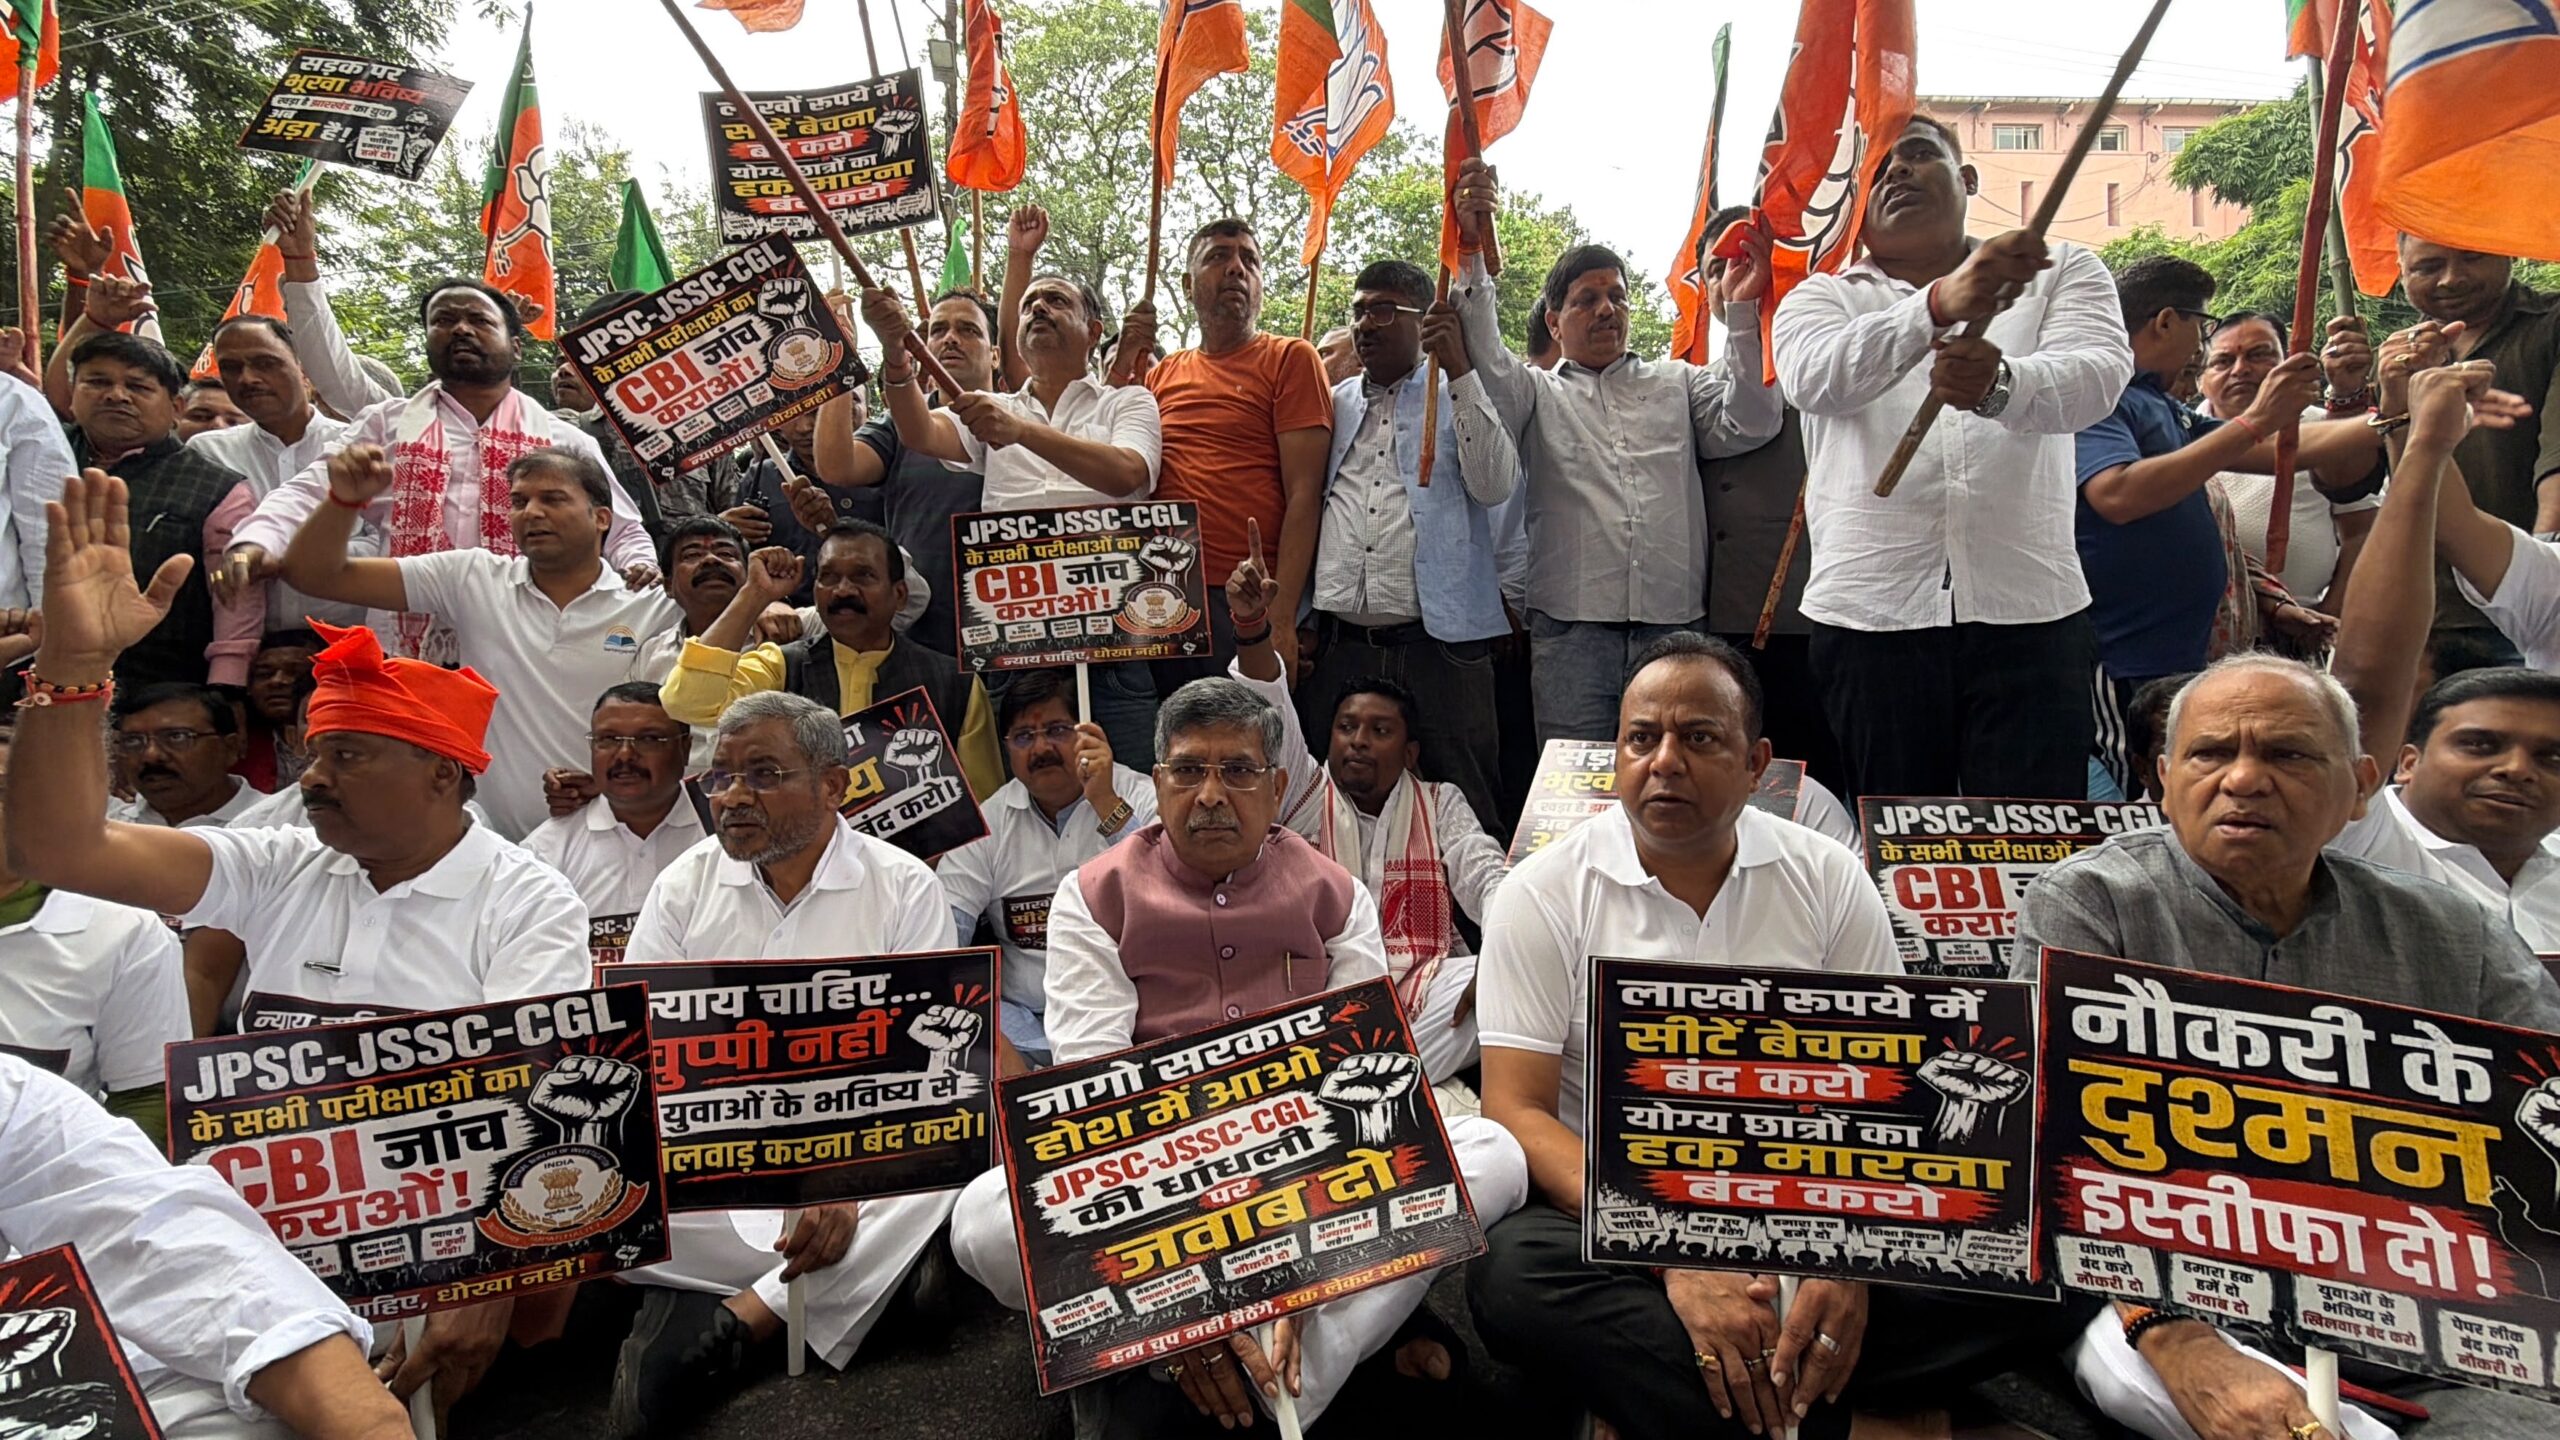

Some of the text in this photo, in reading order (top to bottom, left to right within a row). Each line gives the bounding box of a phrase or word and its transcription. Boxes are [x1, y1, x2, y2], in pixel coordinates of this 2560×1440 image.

[285, 73, 428, 105] भूखा भविष्य
[300, 56, 406, 82] सड़क पर
[874, 76, 900, 98] में
[257, 118, 353, 143] अड़ा है!
[795, 107, 877, 135] बेचना
[797, 132, 855, 155] करो
[847, 153, 879, 169] का
[823, 181, 890, 206] करो
[577, 241, 787, 365] JPSC-JSSC-CGL
[592, 292, 757, 384] के सभी परीक्षाओं का
[615, 318, 762, 415] CBI जांच
[961, 503, 1188, 546] JPSC-JSSC-CGL
[964, 535, 1141, 566] के सभी परीक्षाओं का
[974, 556, 1130, 603] CBI जांच
[1003, 654, 1041, 666] न्याय
[1878, 840, 1904, 862] के
[1907, 839, 1963, 862] सभी
[1892, 866, 2006, 911] CBI
[1616, 979, 1774, 1013] लाखों
[1924, 986, 1988, 1022] में
[184, 992, 627, 1102] JPSC-JSSC-CGL
[783, 1007, 902, 1064] नहीं
[1618, 1014, 1927, 1064] सीटें बेचना
[2064, 973, 2494, 1106] नौकरी के
[1016, 1004, 1329, 1121] जागो सरकार
[1659, 1057, 1872, 1100] बंद करो
[187, 1063, 533, 1143] के सभी परीक्षाओं का
[661, 1069, 962, 1132] युवाओं के भविष्य से
[1024, 1045, 1323, 1163] होश में आओ
[762, 1131, 856, 1167] करना
[860, 1119, 905, 1153] बंद
[1622, 1102, 1923, 1149] योग्य छात्रों का
[2067, 1059, 2502, 1208] दुश्मन
[208, 1108, 509, 1210] CBI जांच
[544, 1158, 576, 1170] INDIA
[1044, 1095, 1319, 1208] JPSC-JSSC-CGL
[1618, 1133, 2012, 1191] हक मारना
[1071, 1121, 1317, 1227] की धांधली
[1205, 1177, 1252, 1209] पर
[1682, 1169, 1948, 1219] बंद करो
[1103, 1148, 1400, 1281] जवाब दो
[2072, 1167, 2368, 1276] इस्तीफा
[2079, 1242, 2126, 1259] धांधली
[2079, 1255, 2133, 1276] बंद करो
[437, 1277, 514, 1304] धोखा
[2075, 1271, 2144, 1294] नौकरी दो
[2182, 1260, 2255, 1285] हमारा हक
[2195, 1278, 2240, 1298] हमें दो
[2186, 1291, 2250, 1315] जवाब दो
[2317, 1283, 2395, 1309] युवाओं के
[2323, 1300, 2396, 1327] भविष्य से
[1110, 1344, 1145, 1365] हम
[1185, 1314, 1227, 1340] नहीं
[2302, 1310, 2417, 1347] खिलवाड़ बंद करो
[2451, 1315, 2526, 1343] पेपर लीक
[2459, 1335, 2520, 1360] बंद करो
[2456, 1351, 2529, 1380] नौकरी दो
